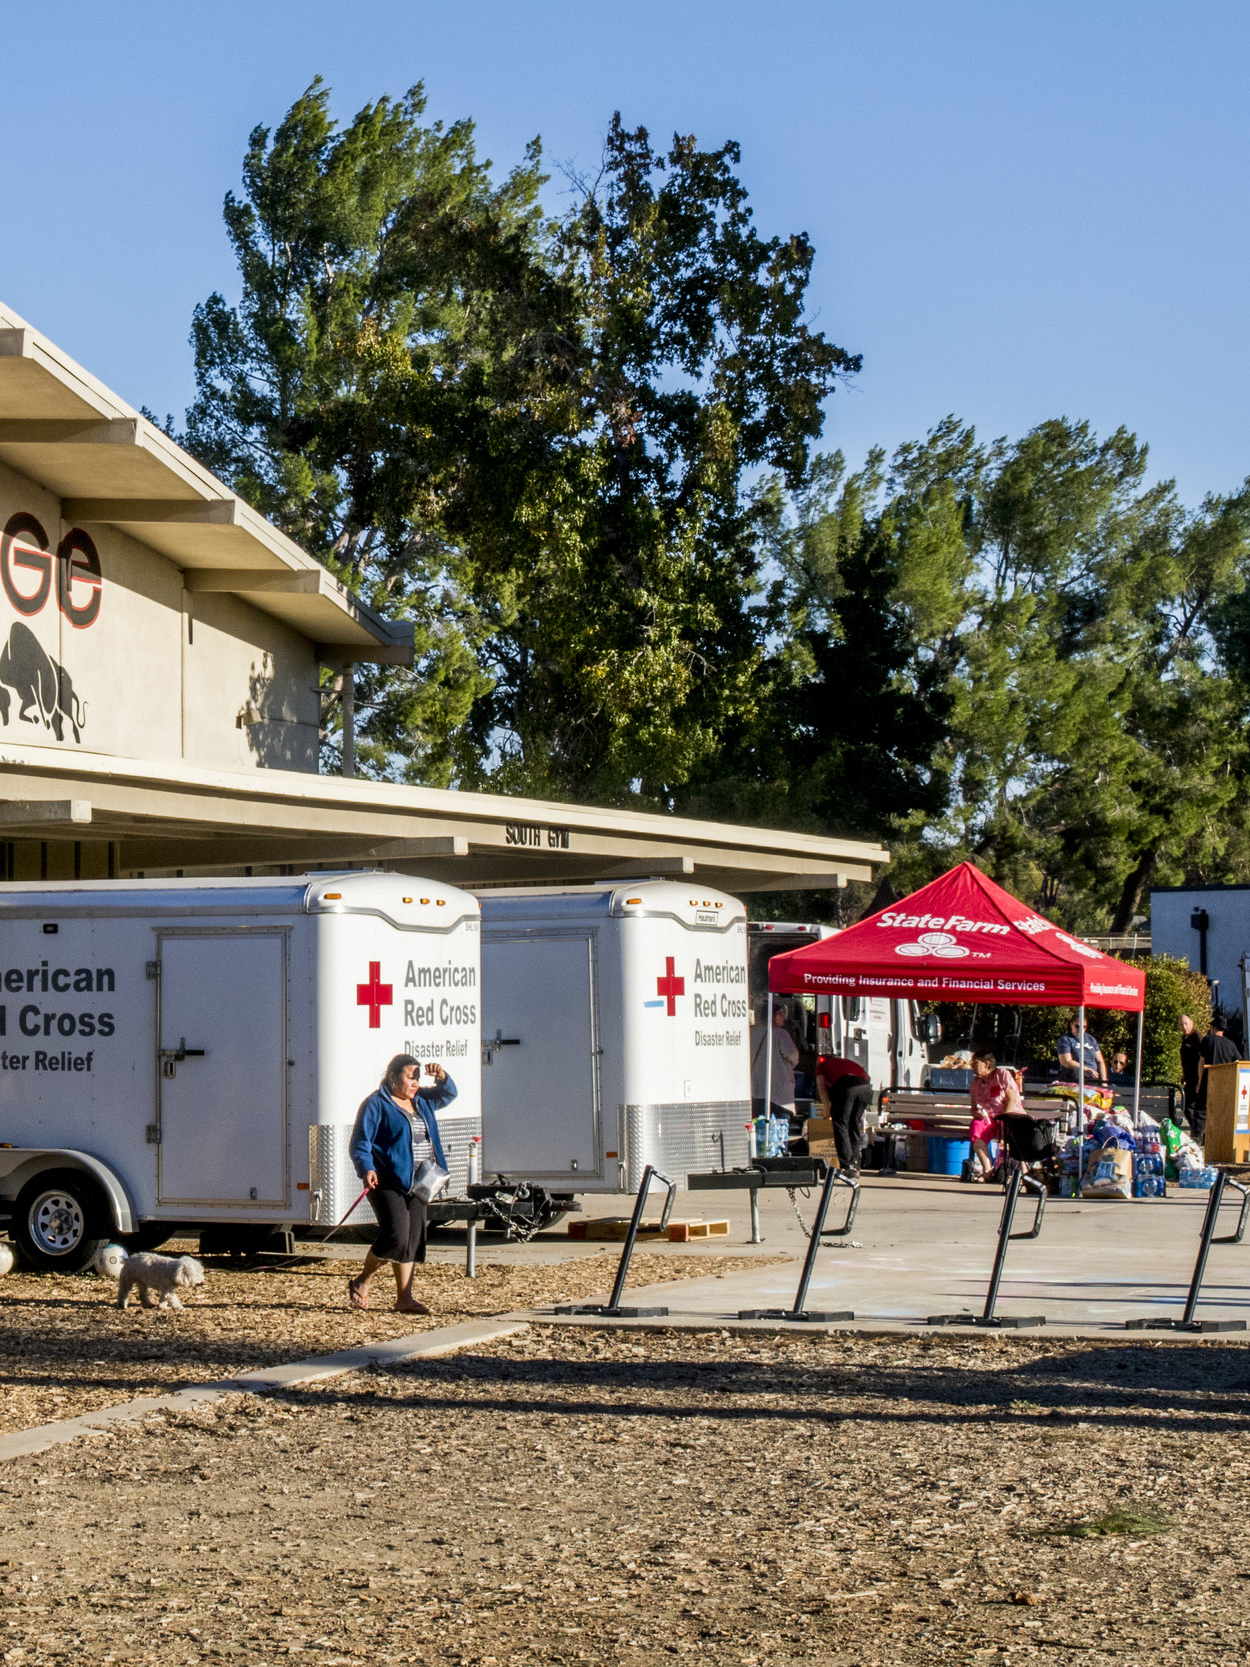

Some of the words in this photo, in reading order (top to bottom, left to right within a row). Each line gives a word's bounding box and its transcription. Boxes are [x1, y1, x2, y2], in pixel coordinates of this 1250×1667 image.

[505, 822, 541, 847] SOUTH
[548, 827, 570, 849] GYM
[404, 960, 476, 988] American
[693, 958, 746, 984] American
[804, 973, 855, 986] Providing
[859, 975, 914, 987] Insurance
[918, 977, 938, 988] and
[942, 977, 994, 990] Financial
[997, 979, 1045, 991] Services
[403, 998, 434, 1027] Red
[439, 998, 477, 1026] Cross
[694, 993, 717, 1018] Red
[721, 993, 747, 1018] Cross
[19, 1004, 116, 1037] Cross
[404, 1040, 444, 1058] Disaster
[445, 1039, 468, 1057] Relief
[695, 1030, 725, 1047] Disaster
[726, 1030, 741, 1047] Relief
[34, 1051, 94, 1073] Relief
